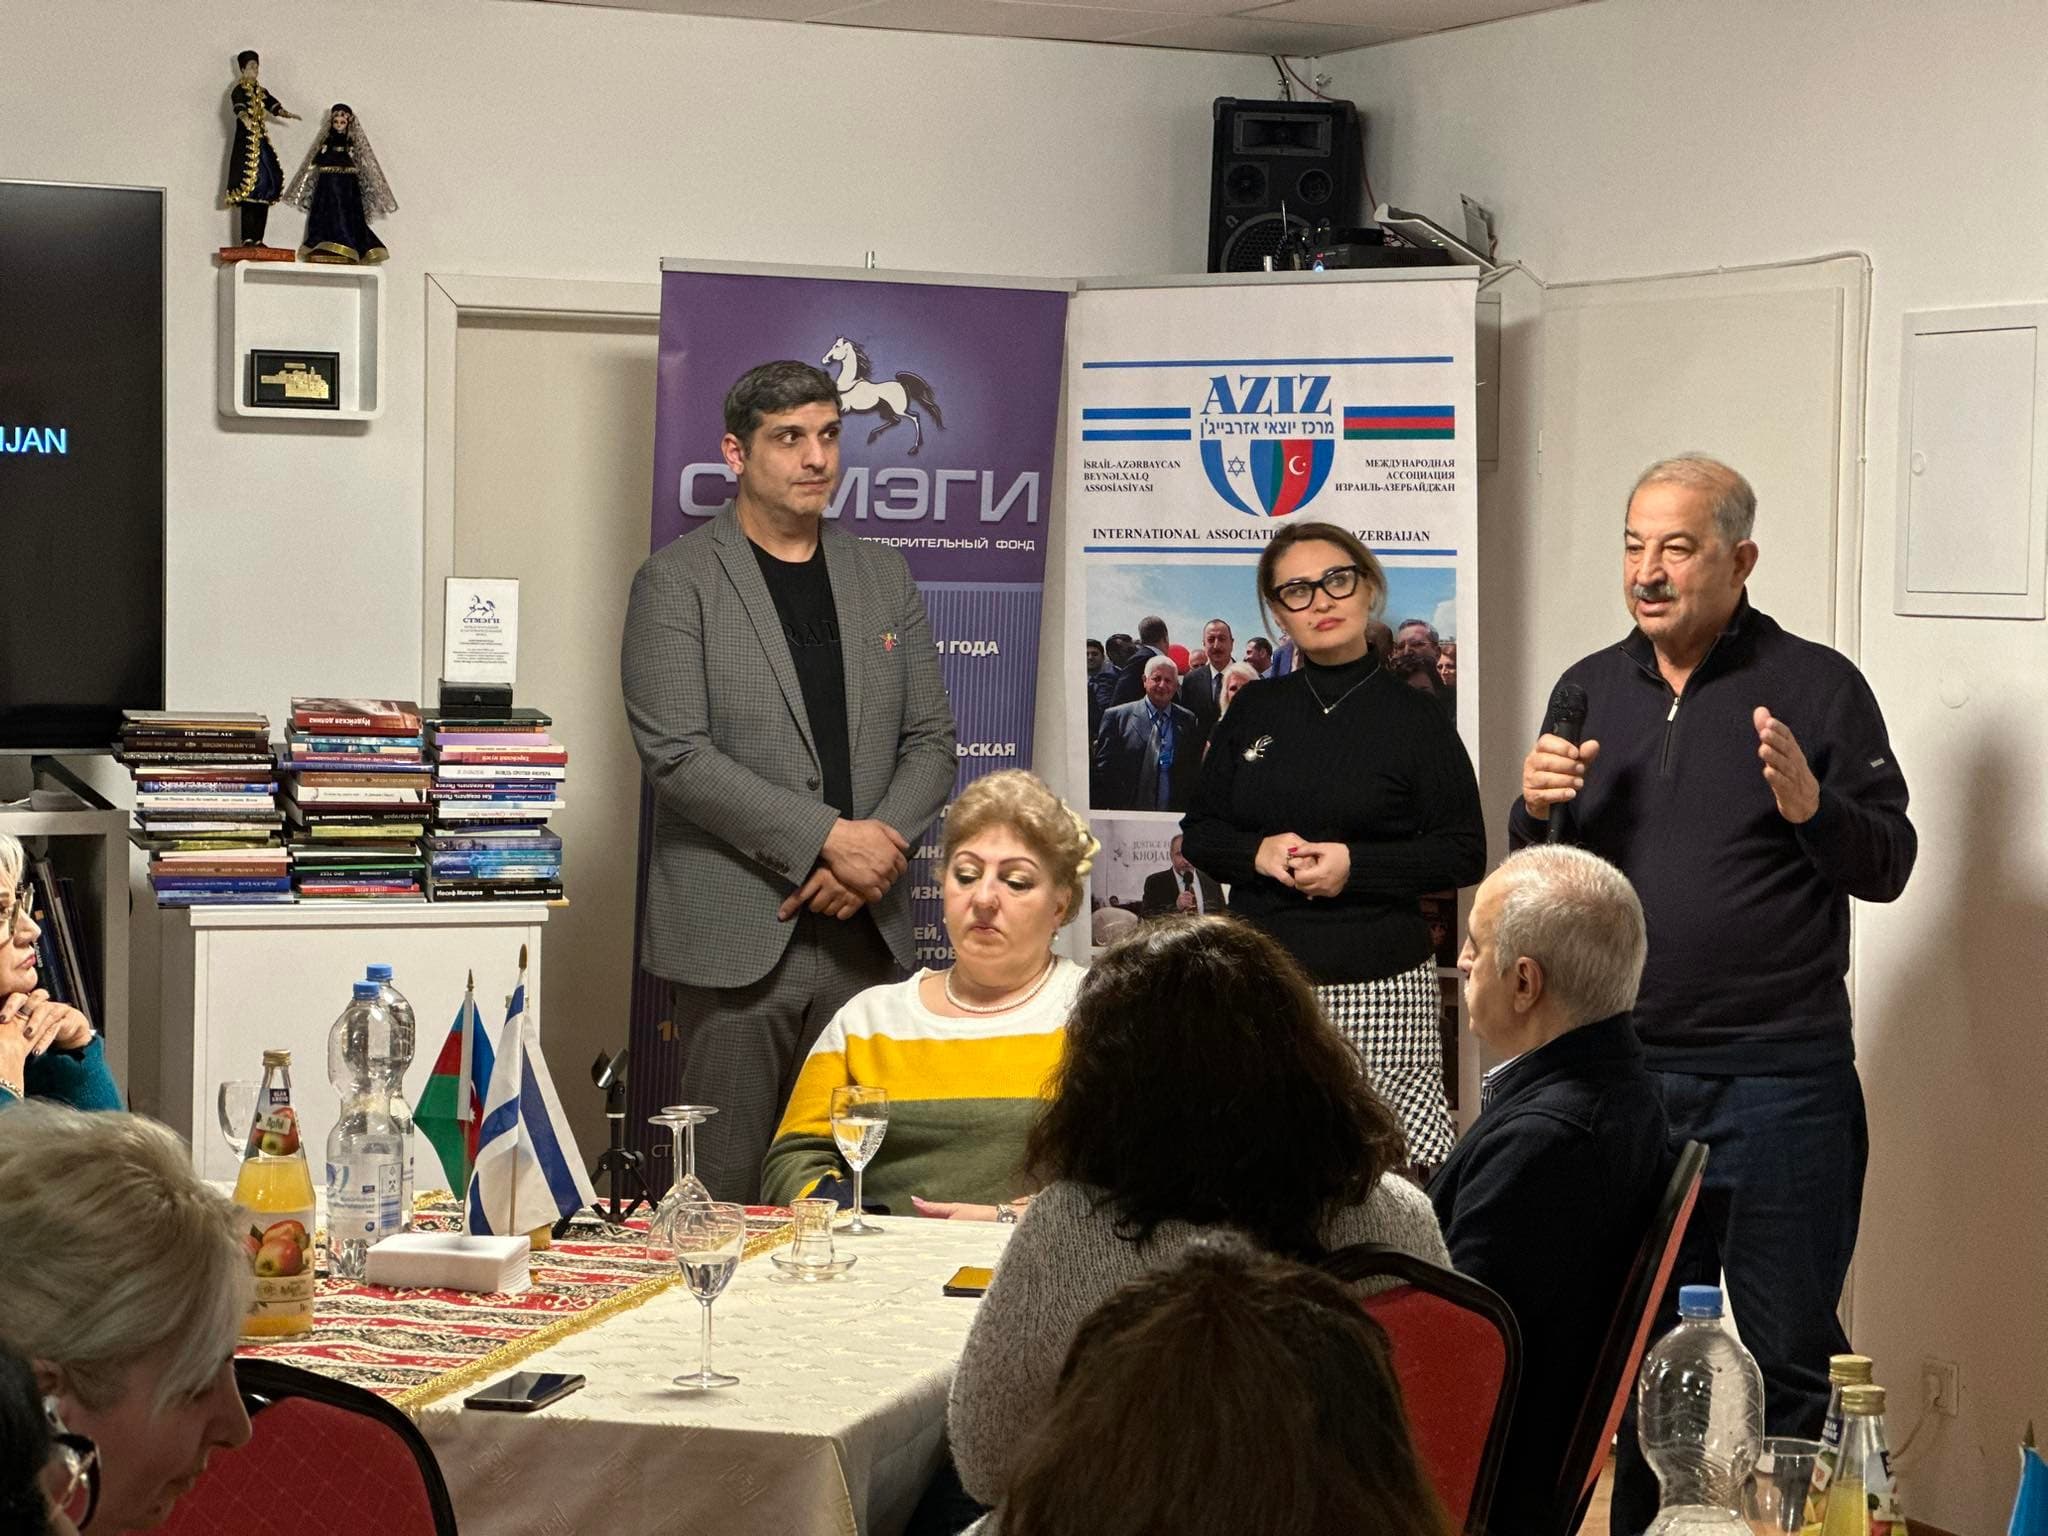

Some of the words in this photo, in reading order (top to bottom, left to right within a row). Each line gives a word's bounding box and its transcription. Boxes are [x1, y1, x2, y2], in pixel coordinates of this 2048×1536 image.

[1200, 373, 1332, 417] AZIZ
[1264, 421, 1296, 434] יוצאי
[1301, 421, 1334, 434] מרכז
[1083, 458, 1181, 469] İSRAİL-AZƏRBAYCAN
[1365, 459, 1455, 469] МЕЖДУНАРОДНАЯ
[1084, 472, 1149, 481] BEYNƏLXALQ
[1386, 471, 1455, 481] АССОЦИАЦИЯ
[680, 463, 1040, 524] СМЭГИ
[1084, 483, 1154, 492] ASSOSİASİYASI
[1335, 482, 1455, 493] ИЗРАИЛЬ-АЗЕРБАЙДЖАН
[1092, 528, 1200, 540] INTERNATIONAL
[996, 539, 1035, 551] ФОНД
[950, 640, 1000, 657] ГОДА
[956, 742, 1017, 757] ЬСКАЯ
